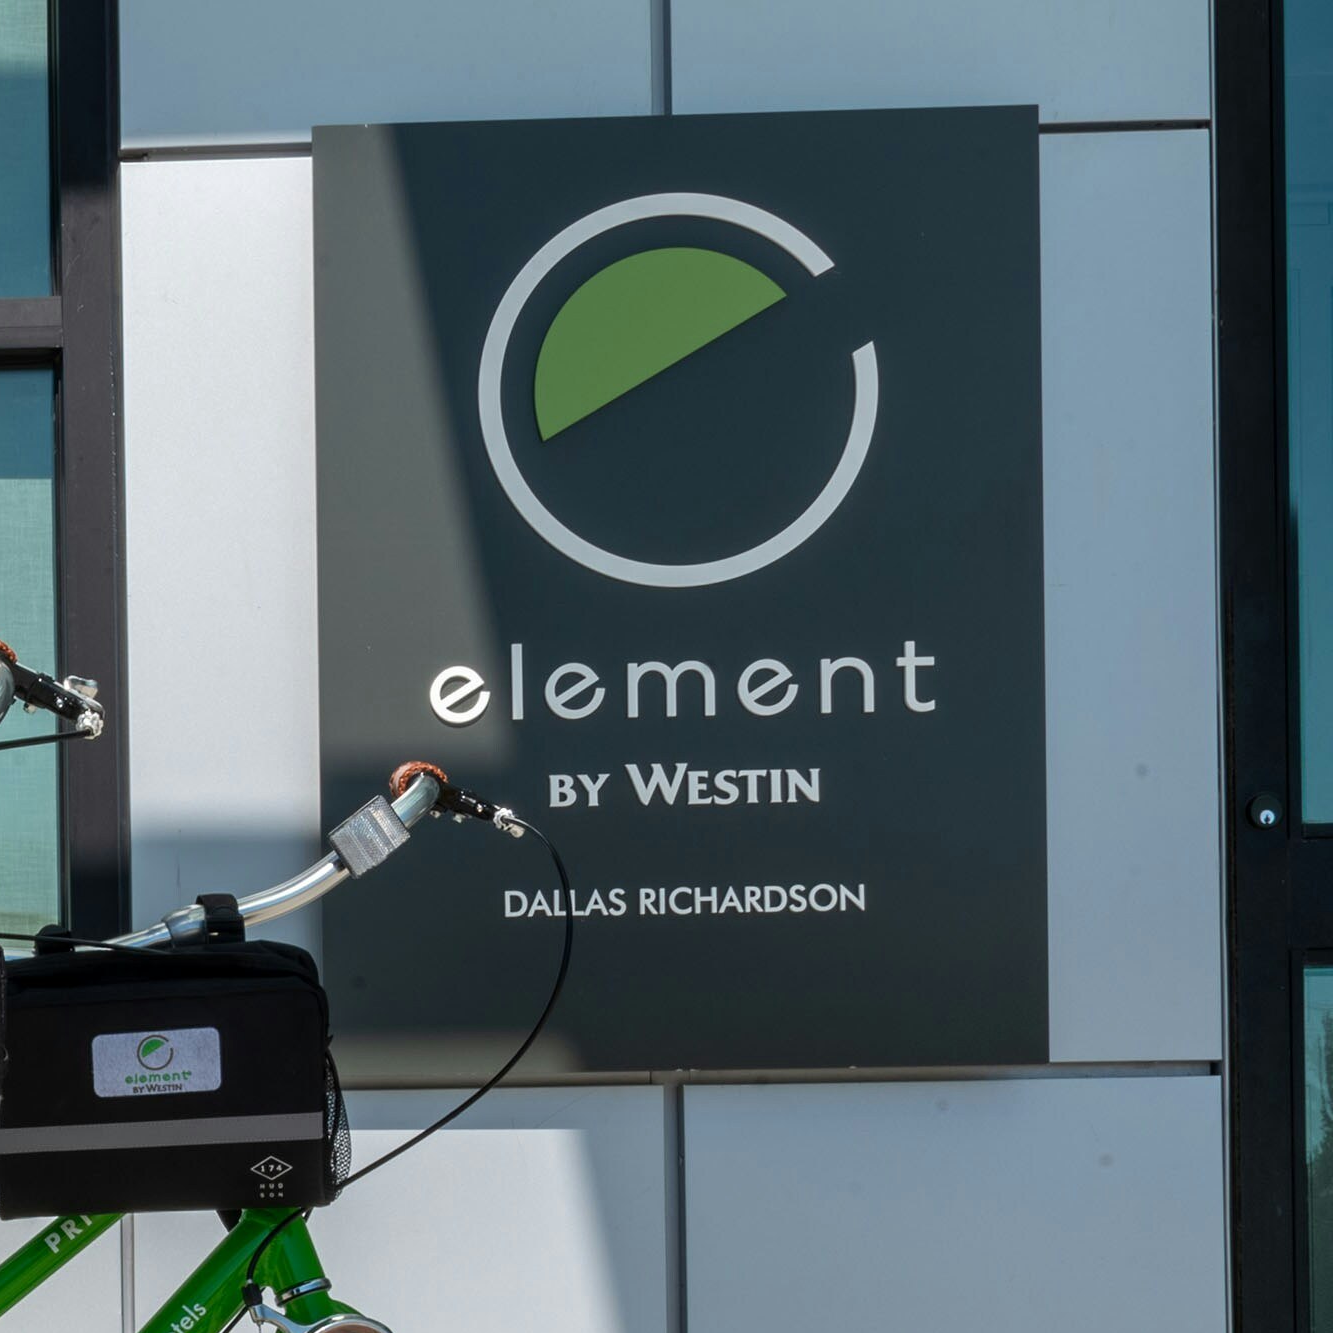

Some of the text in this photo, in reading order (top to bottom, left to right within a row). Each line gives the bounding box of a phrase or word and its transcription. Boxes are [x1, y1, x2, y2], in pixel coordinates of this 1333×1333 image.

[429, 640, 936, 725] element
[548, 762, 821, 807] BY WESTIN
[504, 883, 865, 918] DALLAS RICHARDSON
[133, 1086, 145, 1094] BY
[261, 1164, 283, 1172] 174
